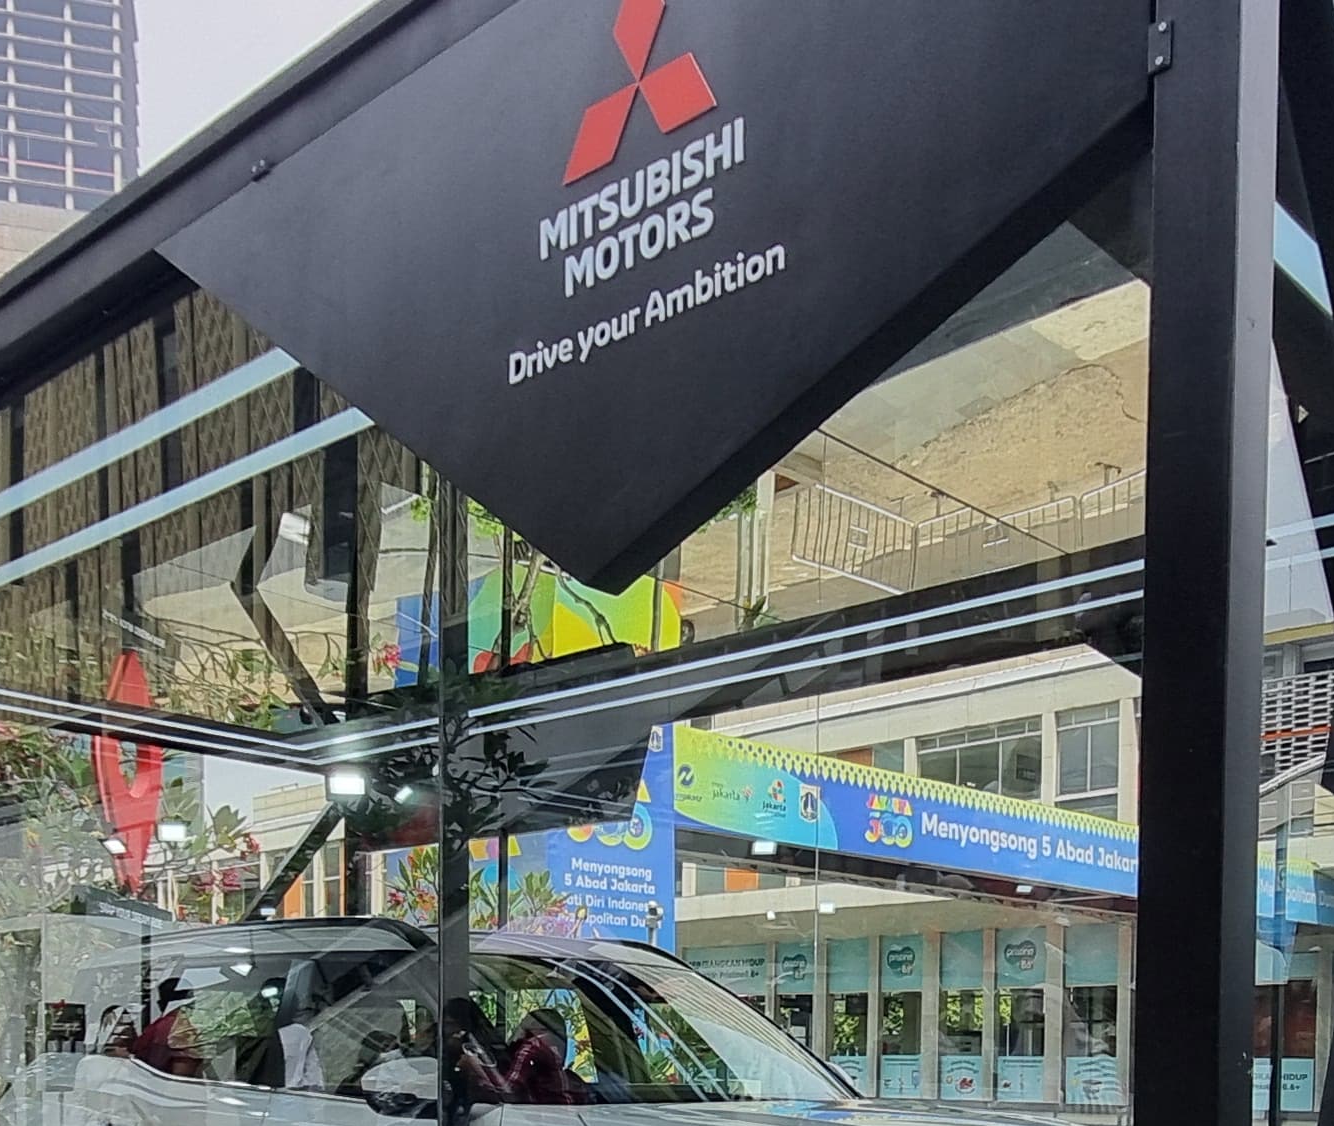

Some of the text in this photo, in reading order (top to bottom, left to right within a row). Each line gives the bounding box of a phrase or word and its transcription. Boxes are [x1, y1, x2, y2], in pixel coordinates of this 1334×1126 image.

[539, 117, 745, 261] MITSUBISHI
[565, 188, 714, 298] MOTORS
[508, 244, 786, 385] Drive your Ambition
[570, 857, 652, 881] Menyongsong
[921, 812, 1139, 874] Menyongsong 5 Abad Jakar
[564, 873, 656, 895] 5 Abad Jakarta
[585, 894, 605, 908] Diri
[608, 897, 649, 912] Indones
